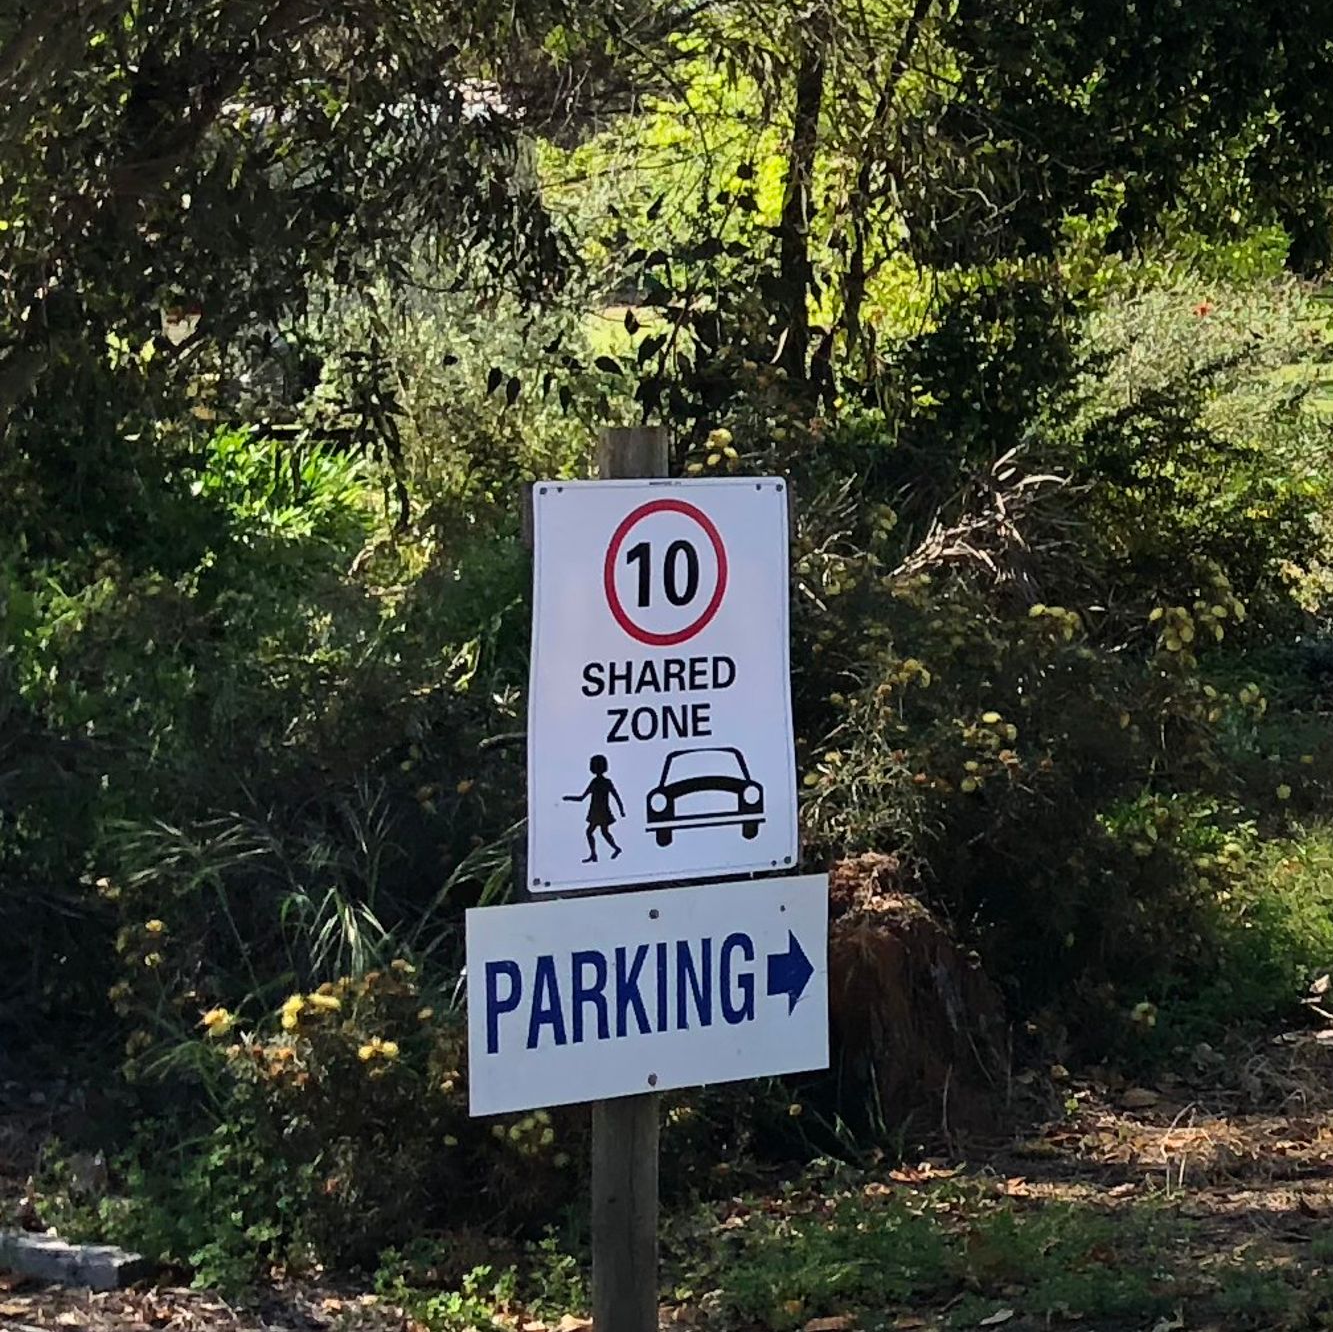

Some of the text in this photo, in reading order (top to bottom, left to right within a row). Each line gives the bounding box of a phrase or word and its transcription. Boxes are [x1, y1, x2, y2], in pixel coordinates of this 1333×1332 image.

[626, 539, 699, 608] 10
[581, 655, 737, 698] SHARED
[606, 702, 713, 744] ZONE
[485, 932, 755, 1054] PARKING
